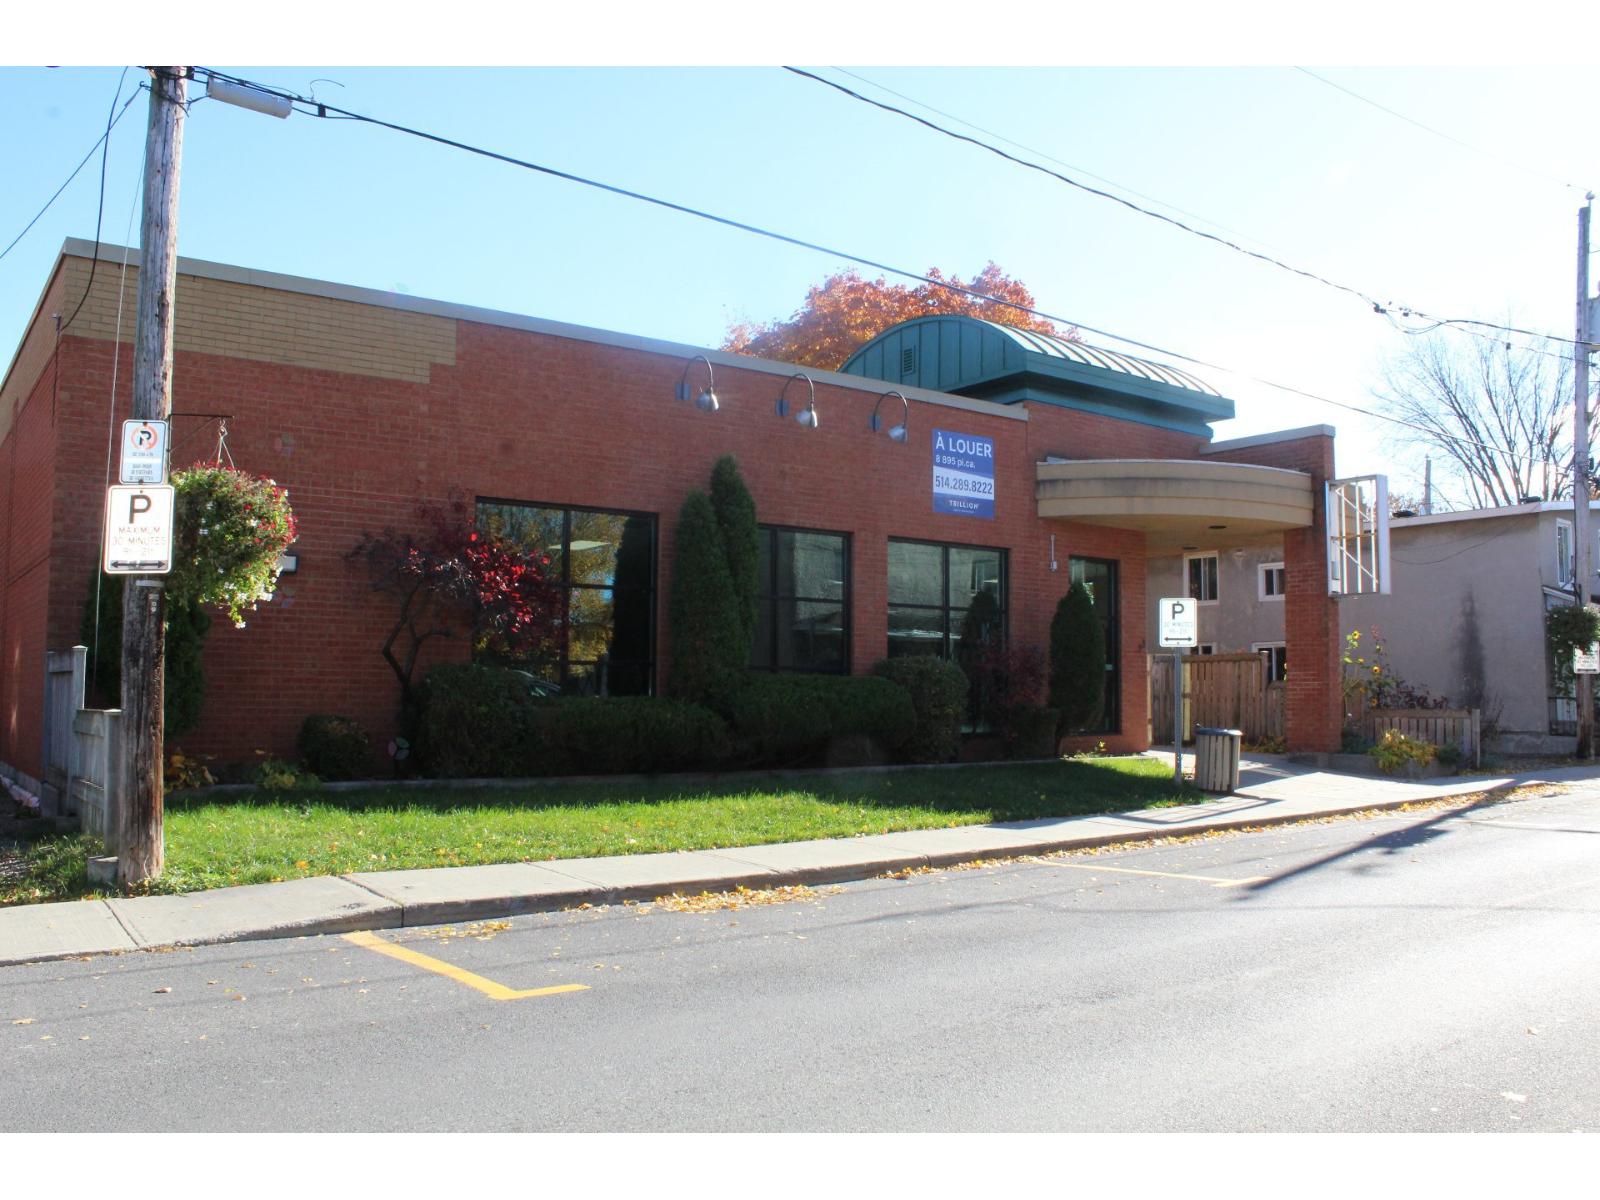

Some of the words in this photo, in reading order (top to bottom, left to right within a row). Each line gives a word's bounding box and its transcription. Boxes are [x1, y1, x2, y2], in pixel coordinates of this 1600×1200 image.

[935, 432, 945, 450] À
[949, 438, 992, 458] LOUER
[935, 454, 941, 463] 8
[942, 455, 956, 466] 895
[935, 475, 993, 495] 514.289.8222
[129, 494, 152, 524] P
[118, 526, 161, 536] MAXIMUM
[1172, 603, 1185, 620] P
